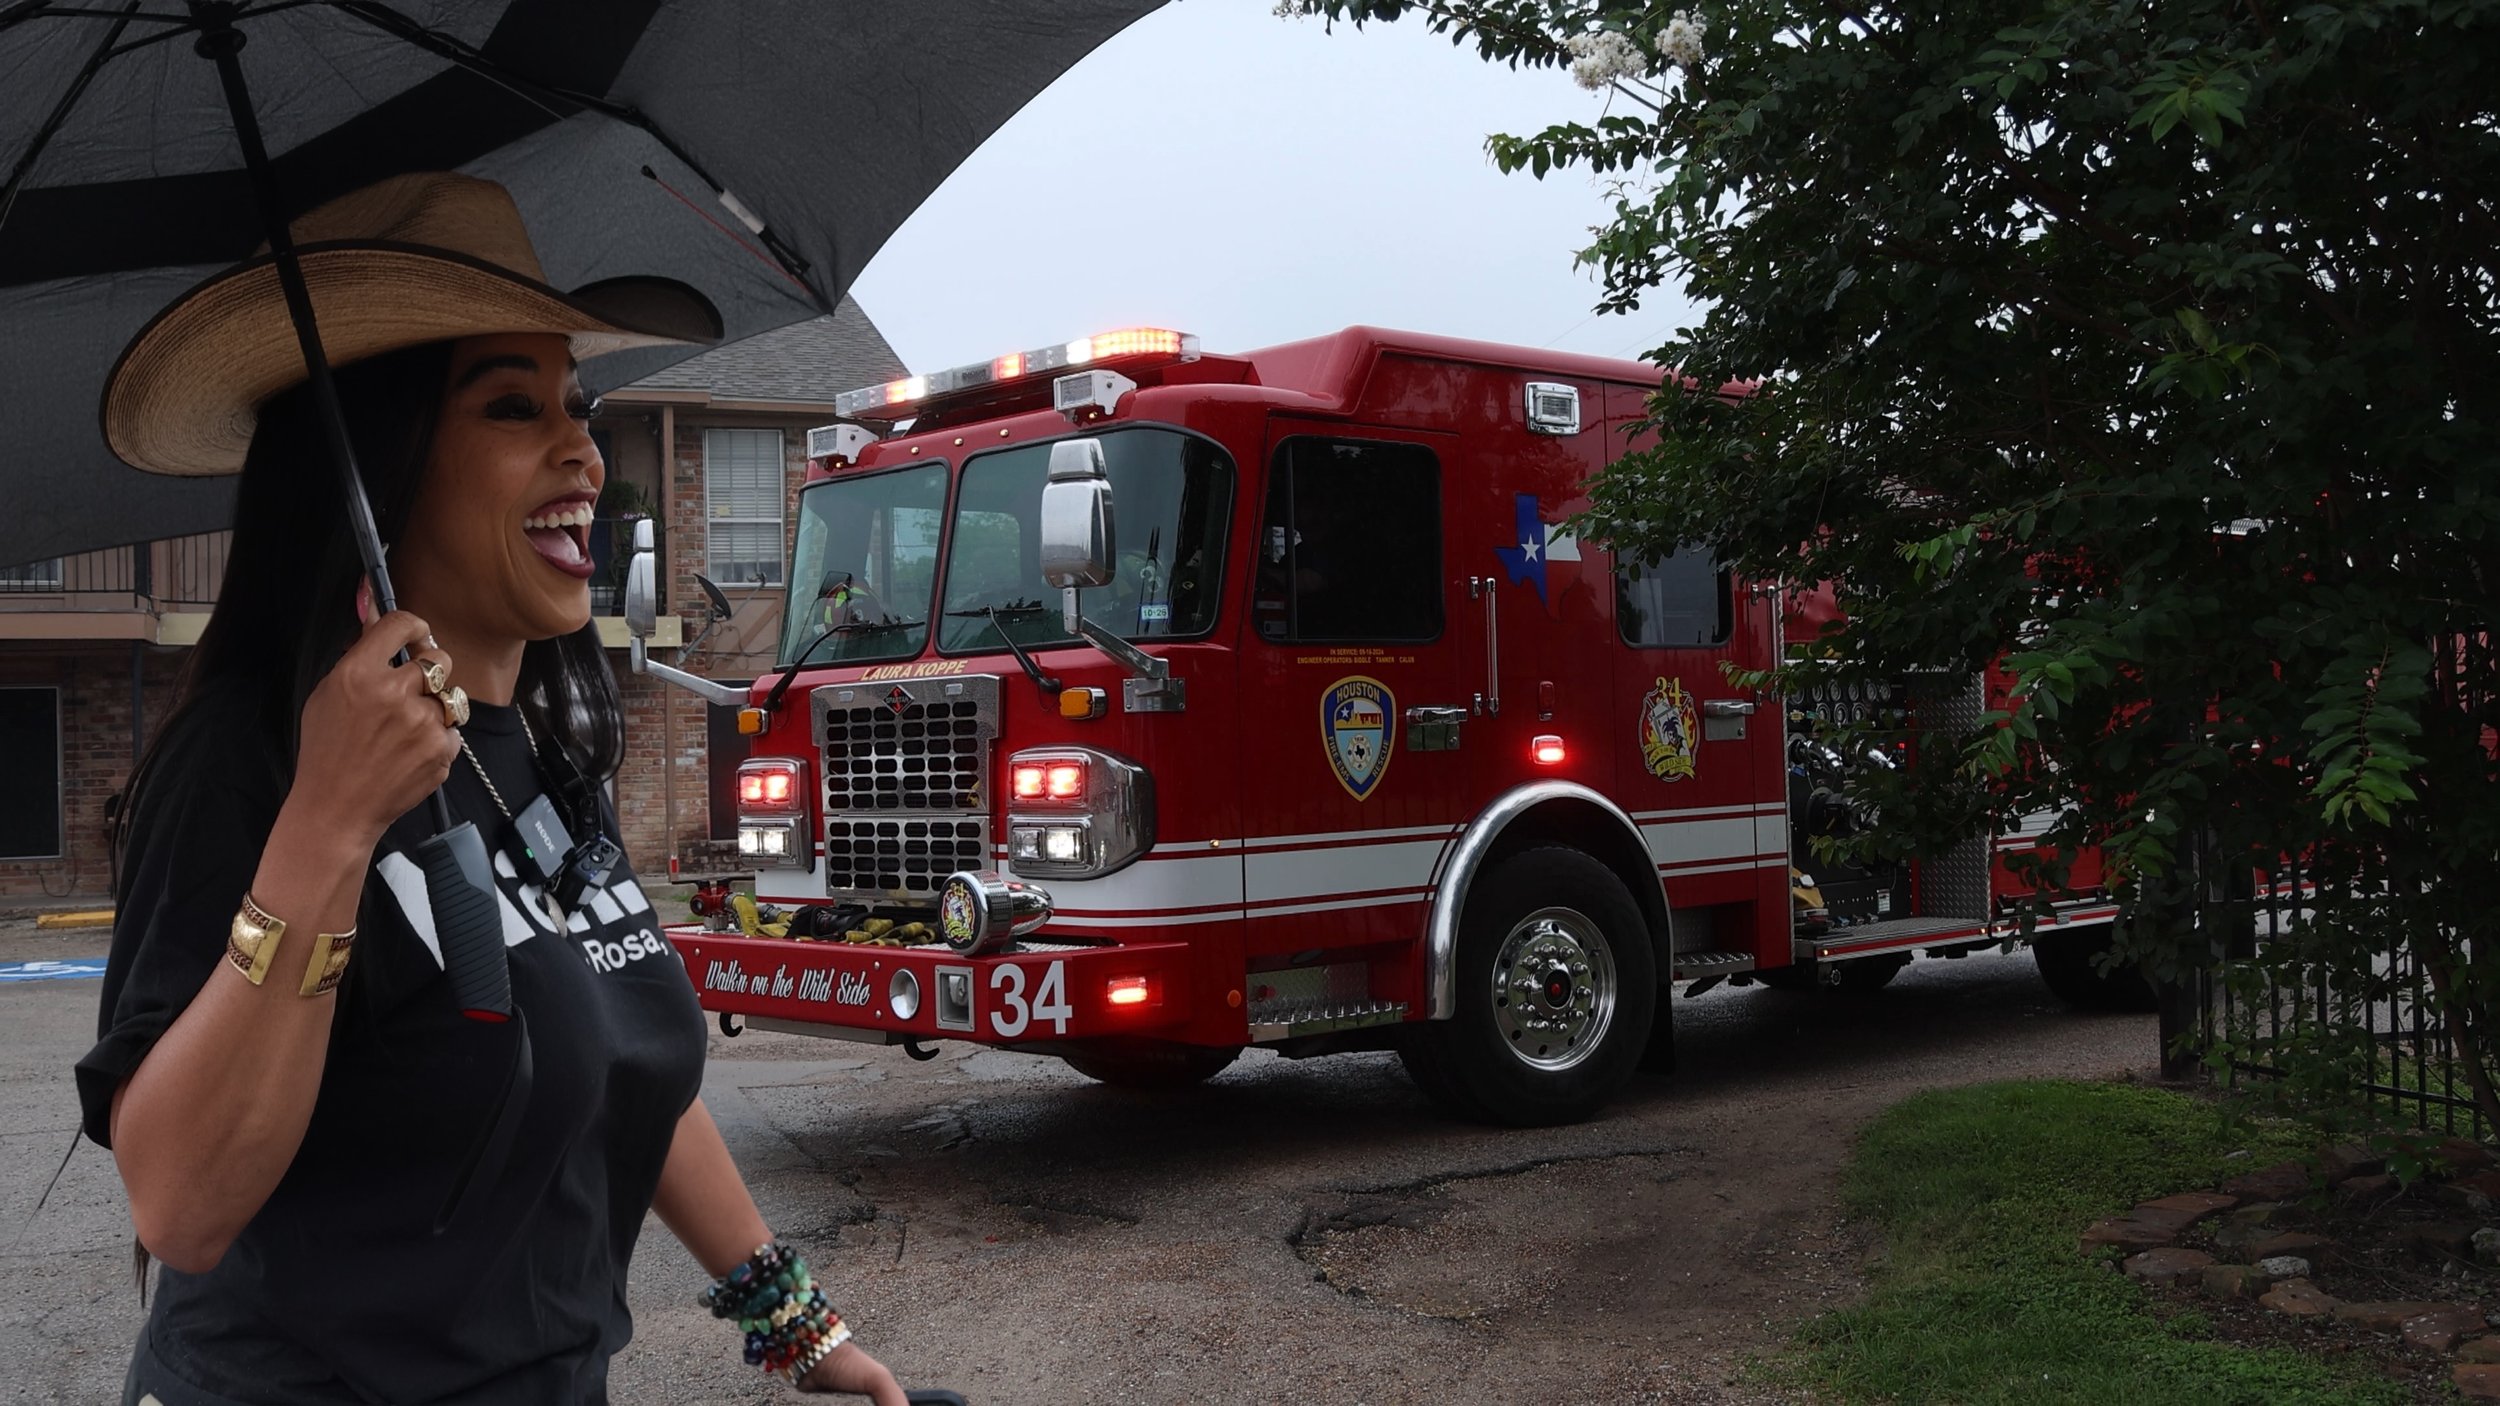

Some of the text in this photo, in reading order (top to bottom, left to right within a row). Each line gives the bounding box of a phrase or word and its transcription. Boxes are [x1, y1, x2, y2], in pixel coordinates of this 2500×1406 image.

[861, 660, 968, 681] LAURA KOPPE
[1337, 682, 1380, 702] HOUSTON
[1655, 676, 1682, 707] 34
[1372, 741, 1389, 778] RESCUE
[705, 960, 870, 1006] Walk'n on the Wild Side
[990, 960, 1073, 1037] 34
